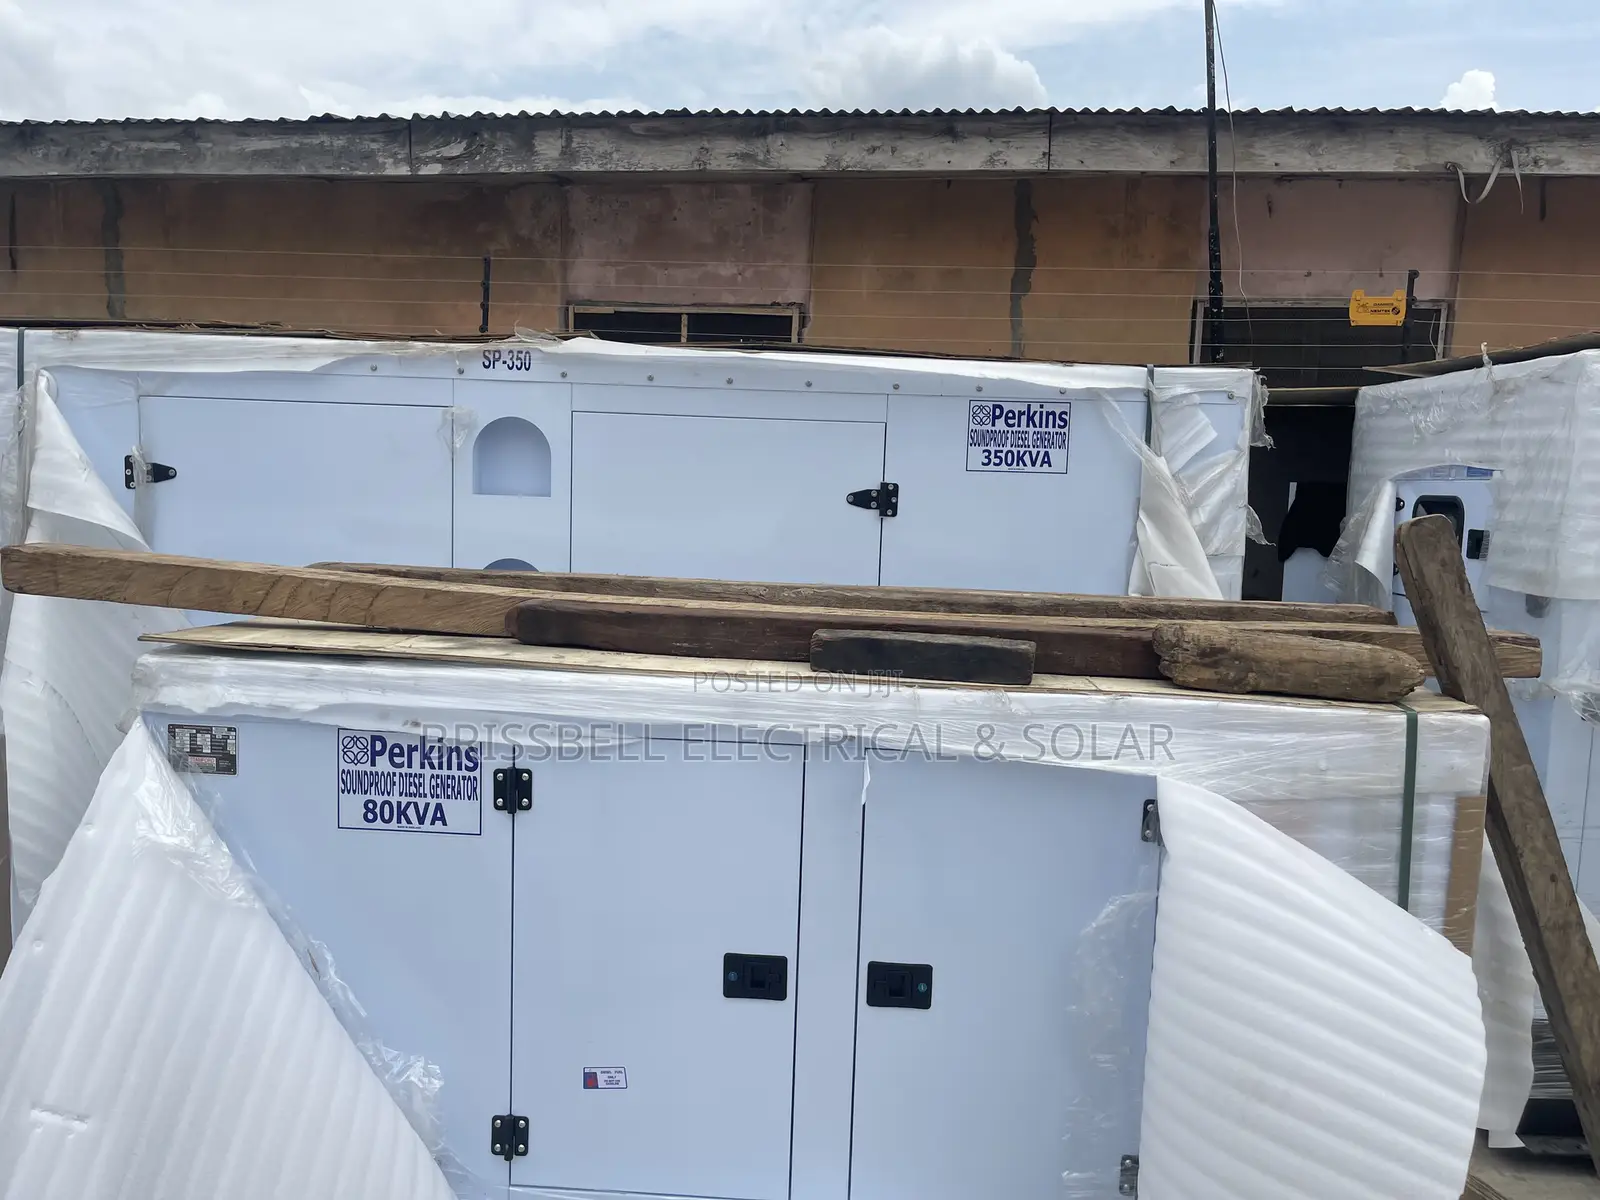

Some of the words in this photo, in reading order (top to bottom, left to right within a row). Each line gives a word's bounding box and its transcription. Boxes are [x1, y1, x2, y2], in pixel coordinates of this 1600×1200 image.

[482, 349, 532, 372] SP-350
[990, 403, 1069, 430] Perkins
[969, 428, 1010, 448] SOUNDPROOF
[1010, 429, 1031, 449] DIESEL
[1031, 430, 1067, 450] GENERATOR
[981, 448, 1053, 468] 350KVA
[369, 734, 480, 773] Perkins
[340, 768, 397, 797] SOUNDPROOF
[398, 771, 428, 799] DIESEL
[429, 773, 479, 801] GENERATOR
[362, 798, 448, 827] 80KVA
